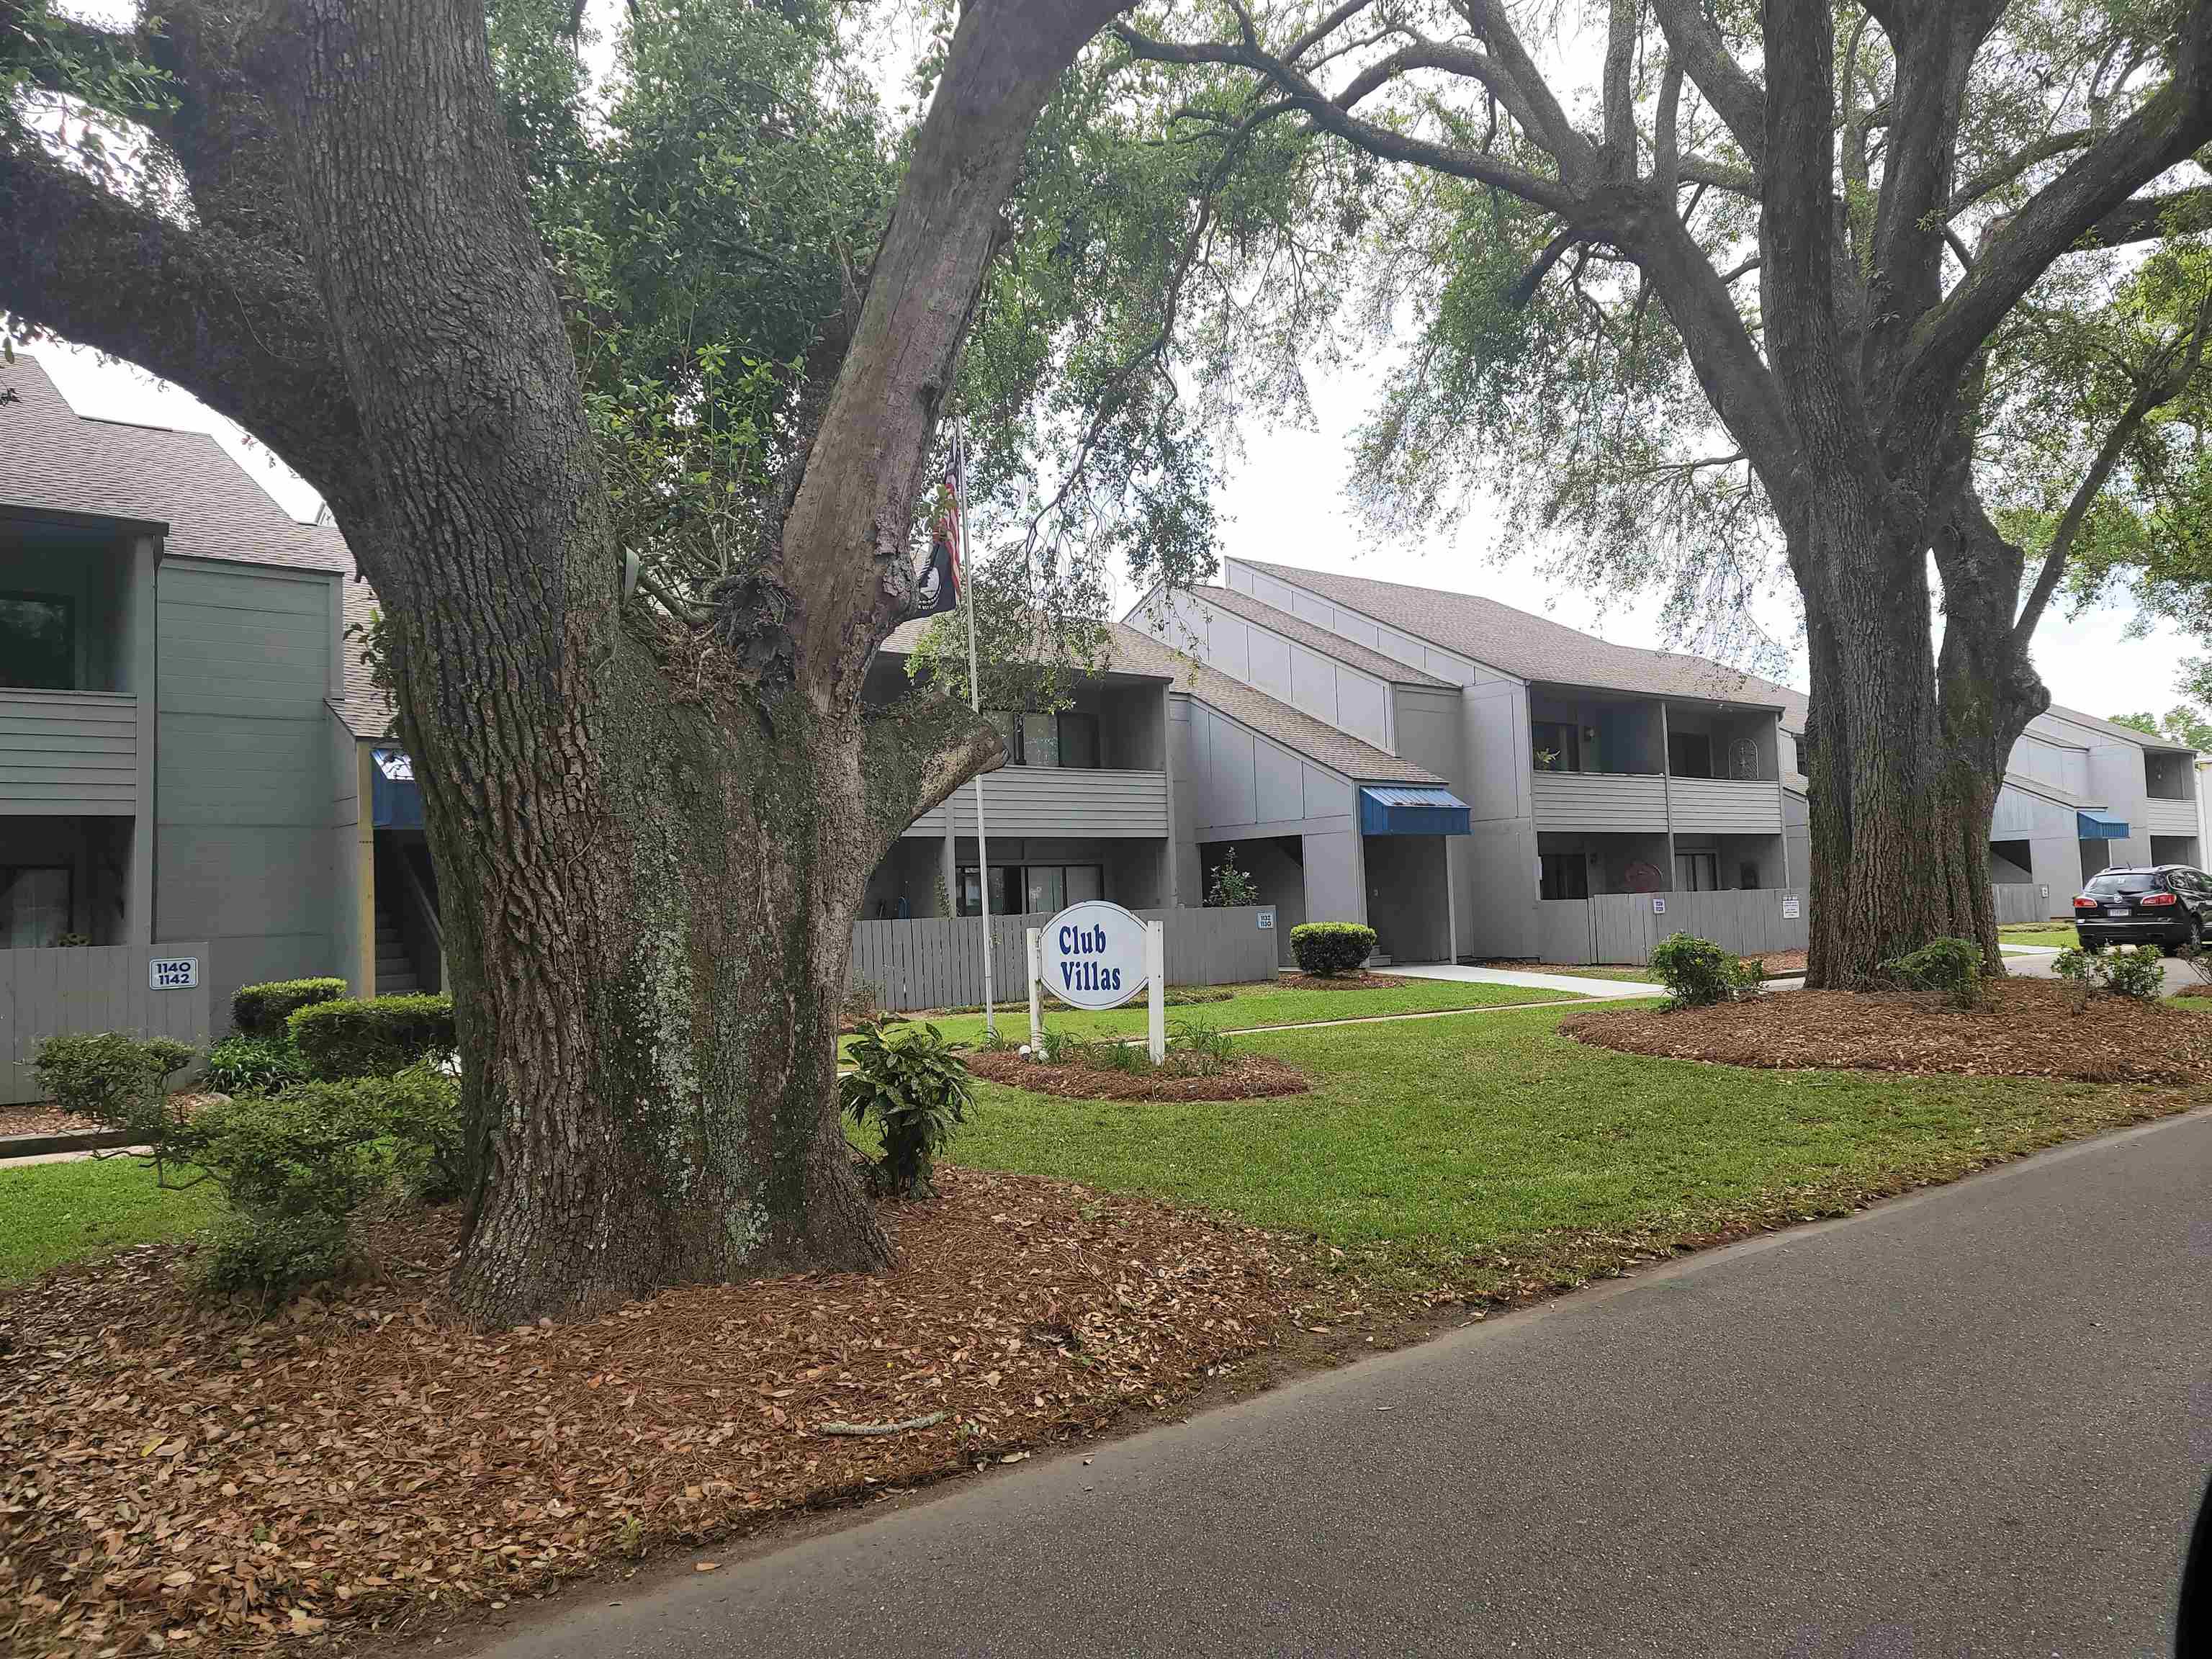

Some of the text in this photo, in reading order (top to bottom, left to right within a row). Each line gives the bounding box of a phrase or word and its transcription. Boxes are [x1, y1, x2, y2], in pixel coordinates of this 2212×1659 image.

[1059, 923, 1106, 955] Club
[156, 962, 191, 974] 1140
[1061, 961, 1120, 991] Villas
[158, 974, 189, 985] 1142
